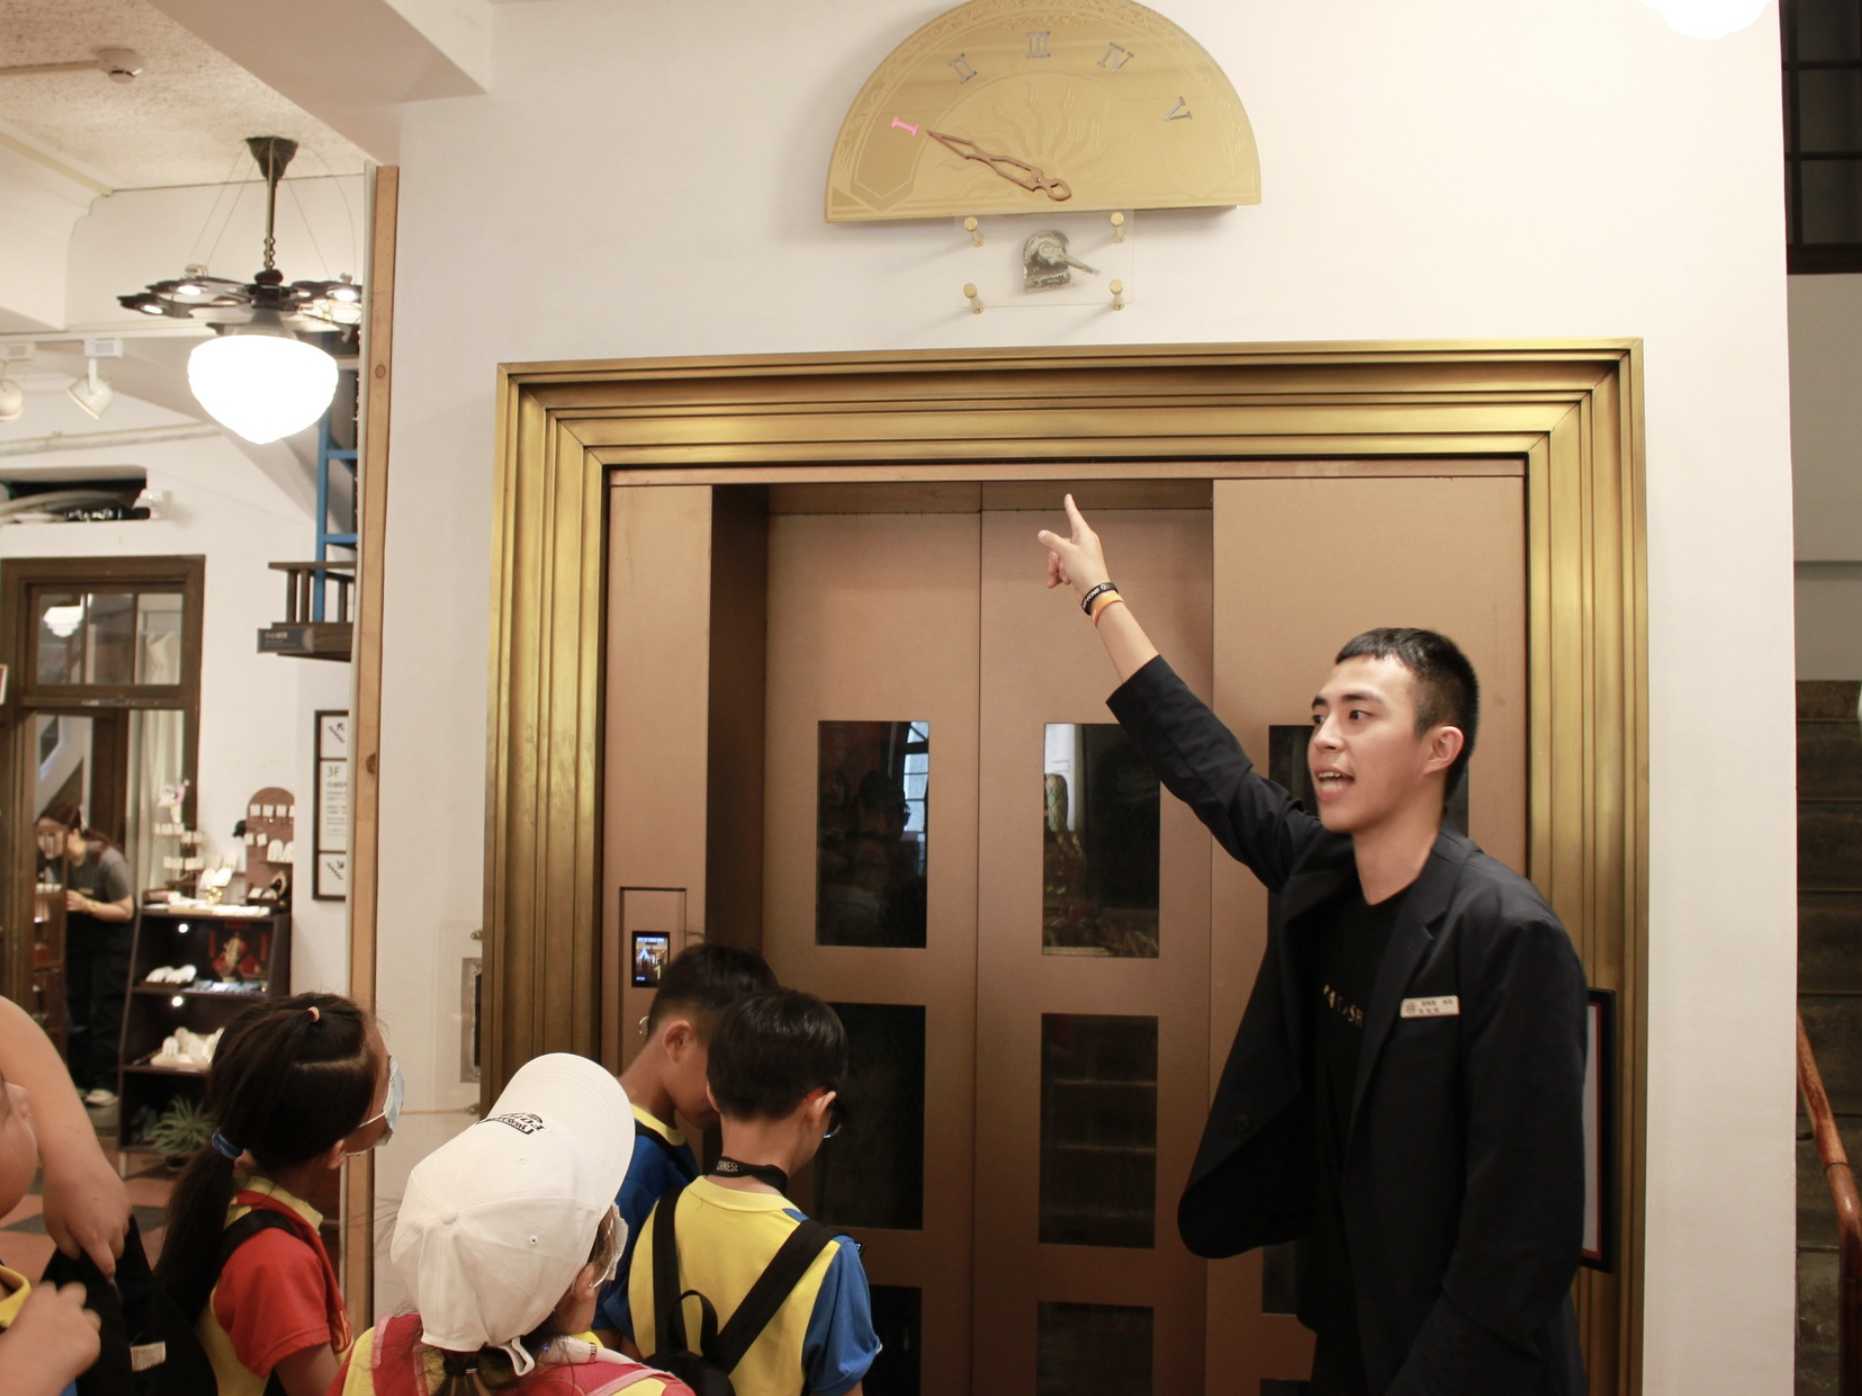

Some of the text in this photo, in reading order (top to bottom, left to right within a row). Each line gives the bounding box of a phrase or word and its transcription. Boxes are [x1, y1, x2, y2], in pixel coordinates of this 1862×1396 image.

[1024, 31, 1051, 58] III
[1097, 41, 1135, 72] IV
[1161, 96, 1193, 121] V
[890, 115, 919, 137] I
